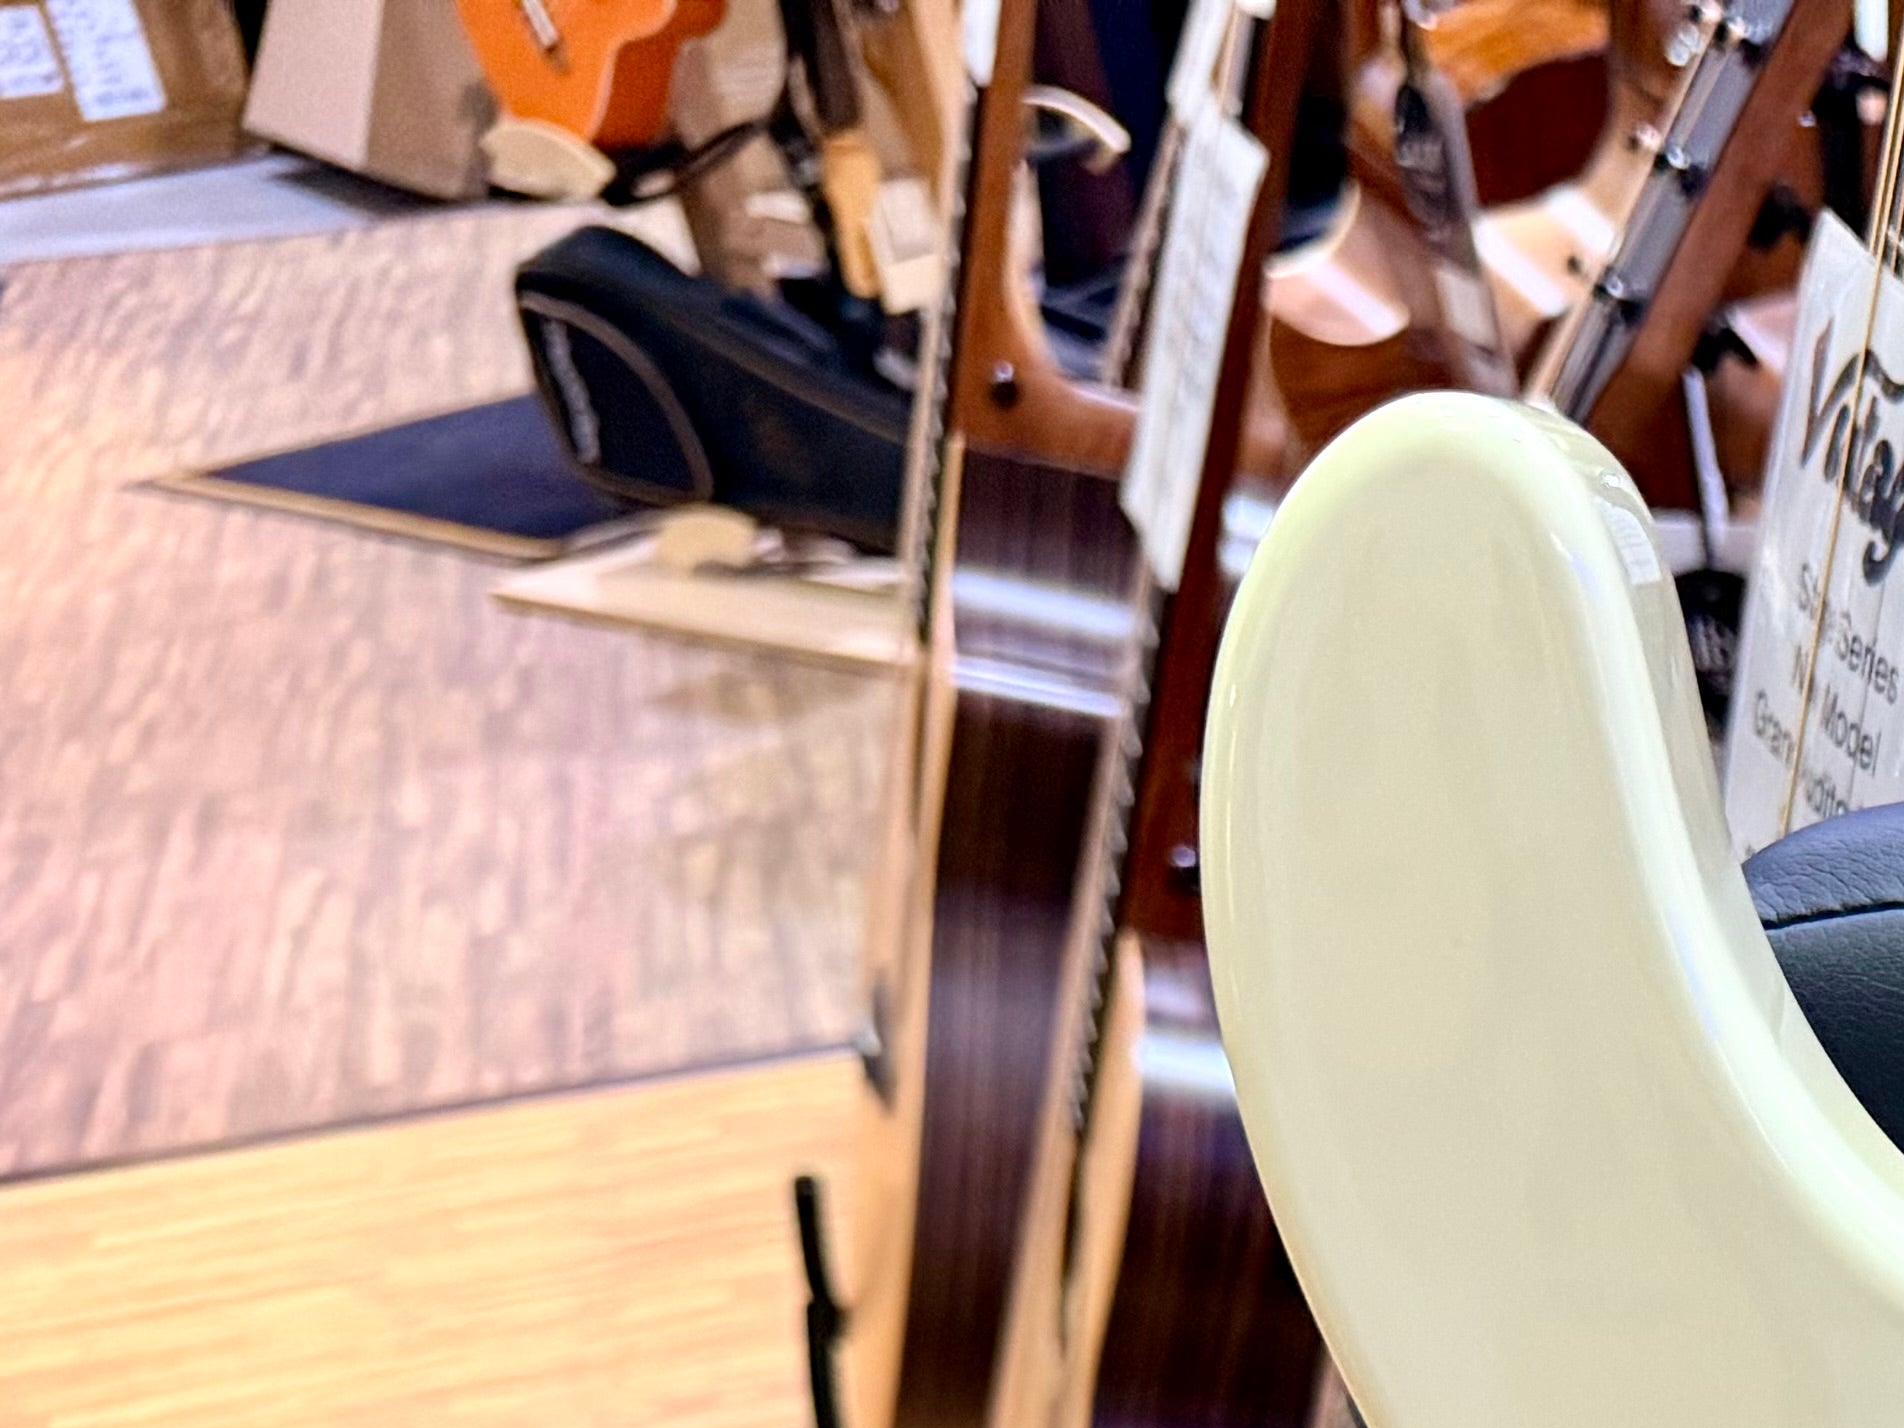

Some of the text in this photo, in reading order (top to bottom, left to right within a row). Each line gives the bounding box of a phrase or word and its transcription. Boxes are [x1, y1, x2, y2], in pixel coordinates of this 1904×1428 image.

[1835, 610, 1898, 705] Series
[1754, 689, 1799, 770] Gran
[1821, 682, 1881, 779] Model
